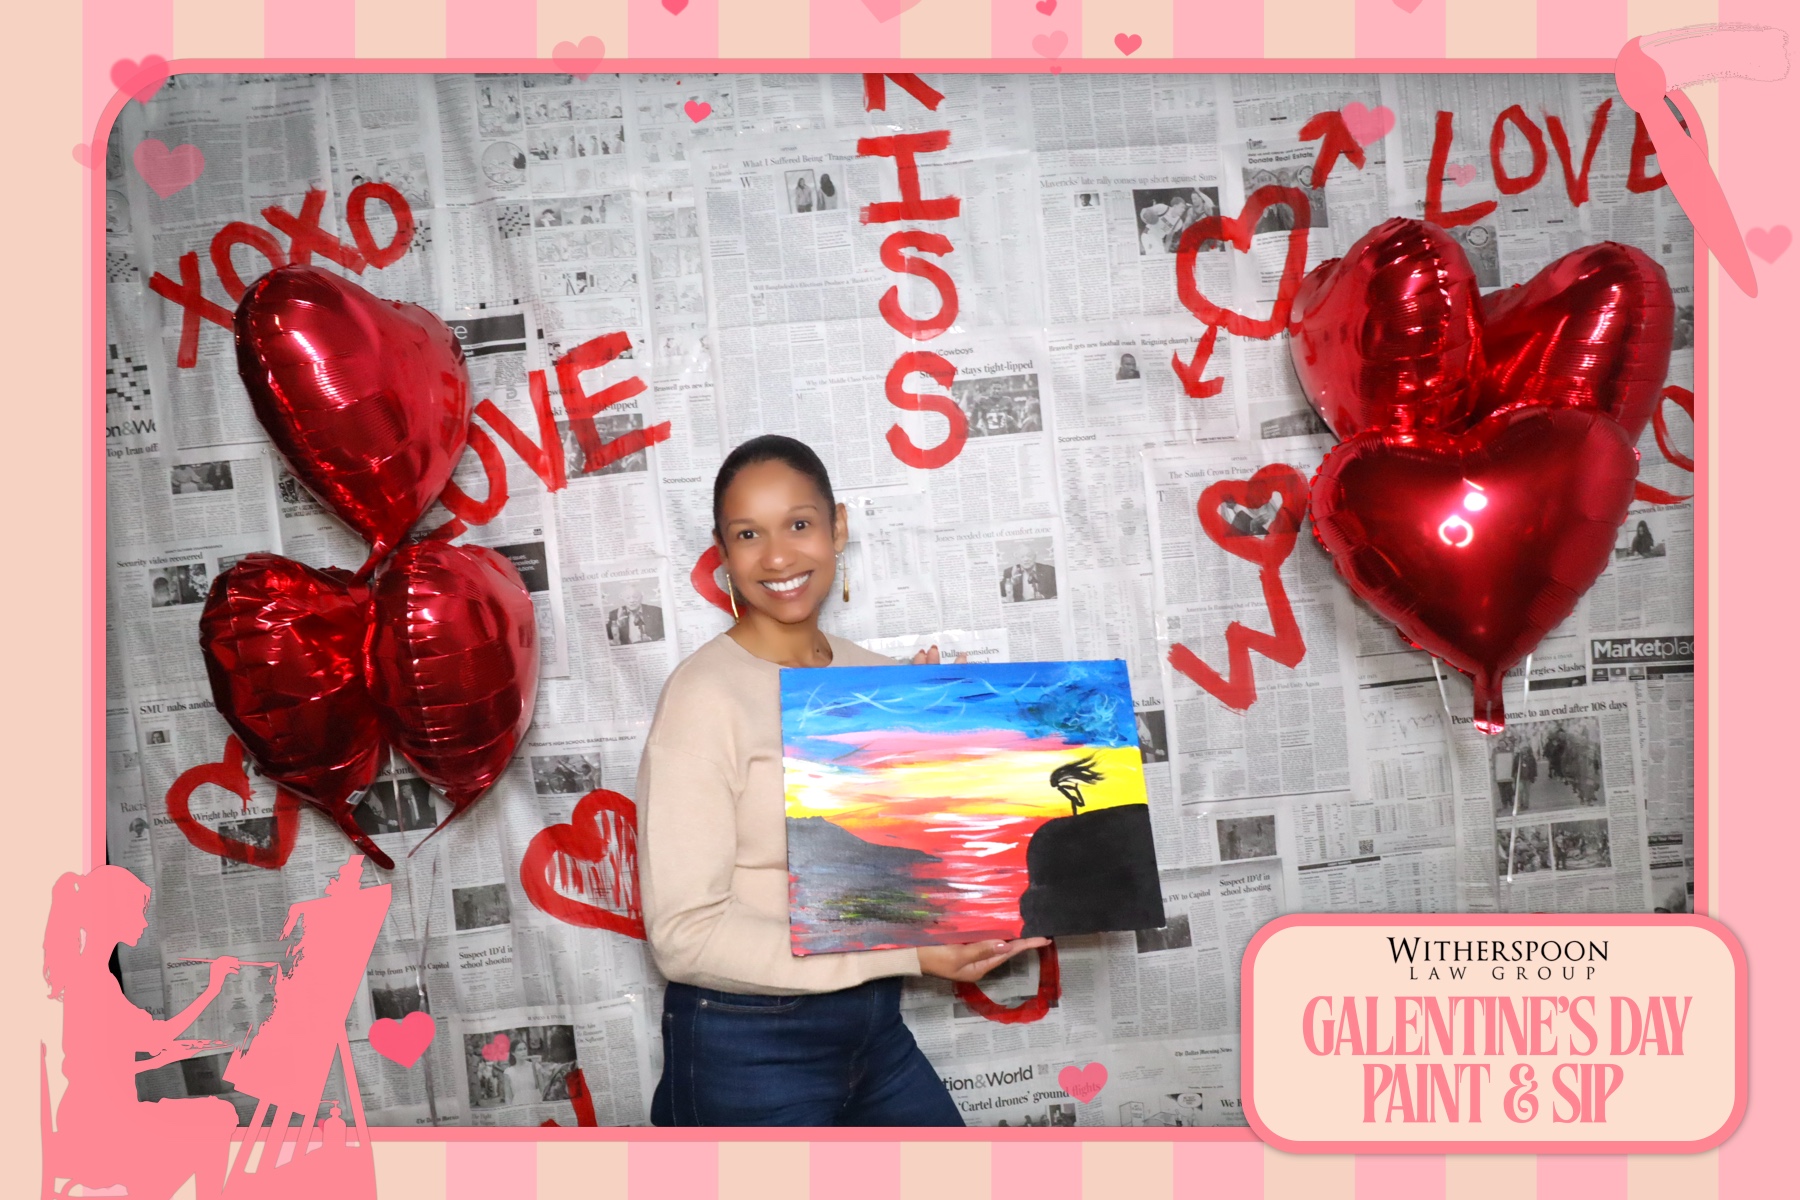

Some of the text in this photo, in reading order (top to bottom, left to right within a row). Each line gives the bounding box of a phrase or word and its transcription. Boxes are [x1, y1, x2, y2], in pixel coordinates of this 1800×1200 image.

[743, 160, 763, 169] What
[771, 155, 801, 166] Suffered
[802, 154, 823, 164] Being
[1248, 156, 1274, 164] Donate
[1275, 154, 1291, 162] Real
[1039, 174, 1218, 189] Mavericks' late rally comes up short against Suns
[961, 359, 1034, 377] stays tight-lipped
[1058, 434, 1096, 443] Scoreboard
[662, 475, 702, 484] Scoreboard
[1168, 471, 1183, 480] The
[1185, 469, 1206, 478] Saudi
[1207, 468, 1230, 477] Crown
[1231, 466, 1254, 475] Prince
[934, 534, 955, 543] Jones
[956, 531, 982, 541] needed
[996, 529, 1004, 538] of
[1005, 527, 1033, 537] comfort
[1035, 526, 1052, 534] zone
[116, 551, 204, 569] Security video recovered
[562, 567, 658, 583] needed out of comfort zone
[1557, 662, 1586, 673] Slashes
[1142, 696, 1161, 707] talks
[1527, 709, 1537, 717] to
[1551, 705, 1568, 716] end
[1568, 703, 1589, 714] after
[1590, 701, 1607, 711] 108
[1608, 700, 1628, 713] days
[140, 702, 187, 716] SMU nabs
[192, 807, 221, 822] Wright
[222, 805, 239, 820] help
[1219, 877, 1245, 887] Suspect
[1263, 873, 1271, 881] in
[1168, 894, 1181, 902] FW
[1189, 888, 1211, 900] Capitol
[1220, 883, 1272, 897] school shooting
[458, 950, 487, 960] Suspect
[386, 967, 404, 975] from
[427, 961, 450, 972] Capitol
[460, 958, 483, 970] school
[958, 1080, 1102, 1113] 'Cartel drones' ground flights
[1220, 1098, 1235, 1108] We
